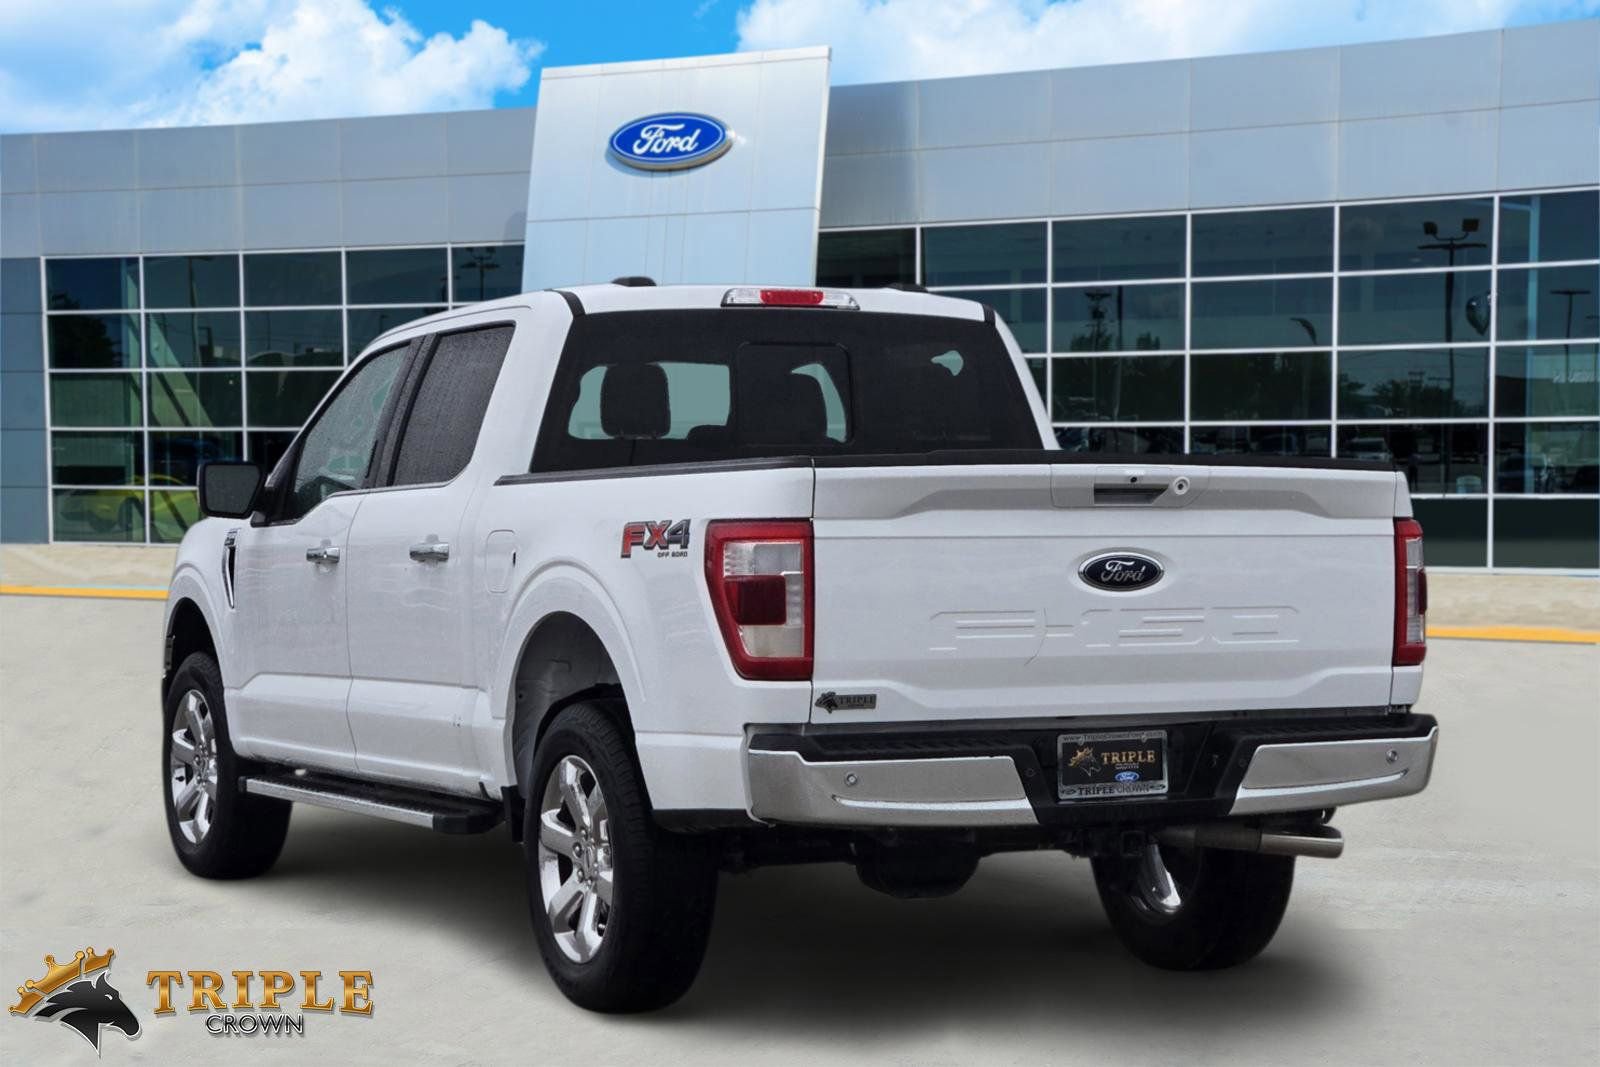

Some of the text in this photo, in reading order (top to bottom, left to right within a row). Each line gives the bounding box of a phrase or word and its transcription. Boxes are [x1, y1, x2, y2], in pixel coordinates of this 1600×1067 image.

[632, 123, 701, 155] Ford
[620, 519, 691, 558] FX4
[1101, 560, 1146, 582] Ford
[1101, 750, 1156, 765] TRIPLE
